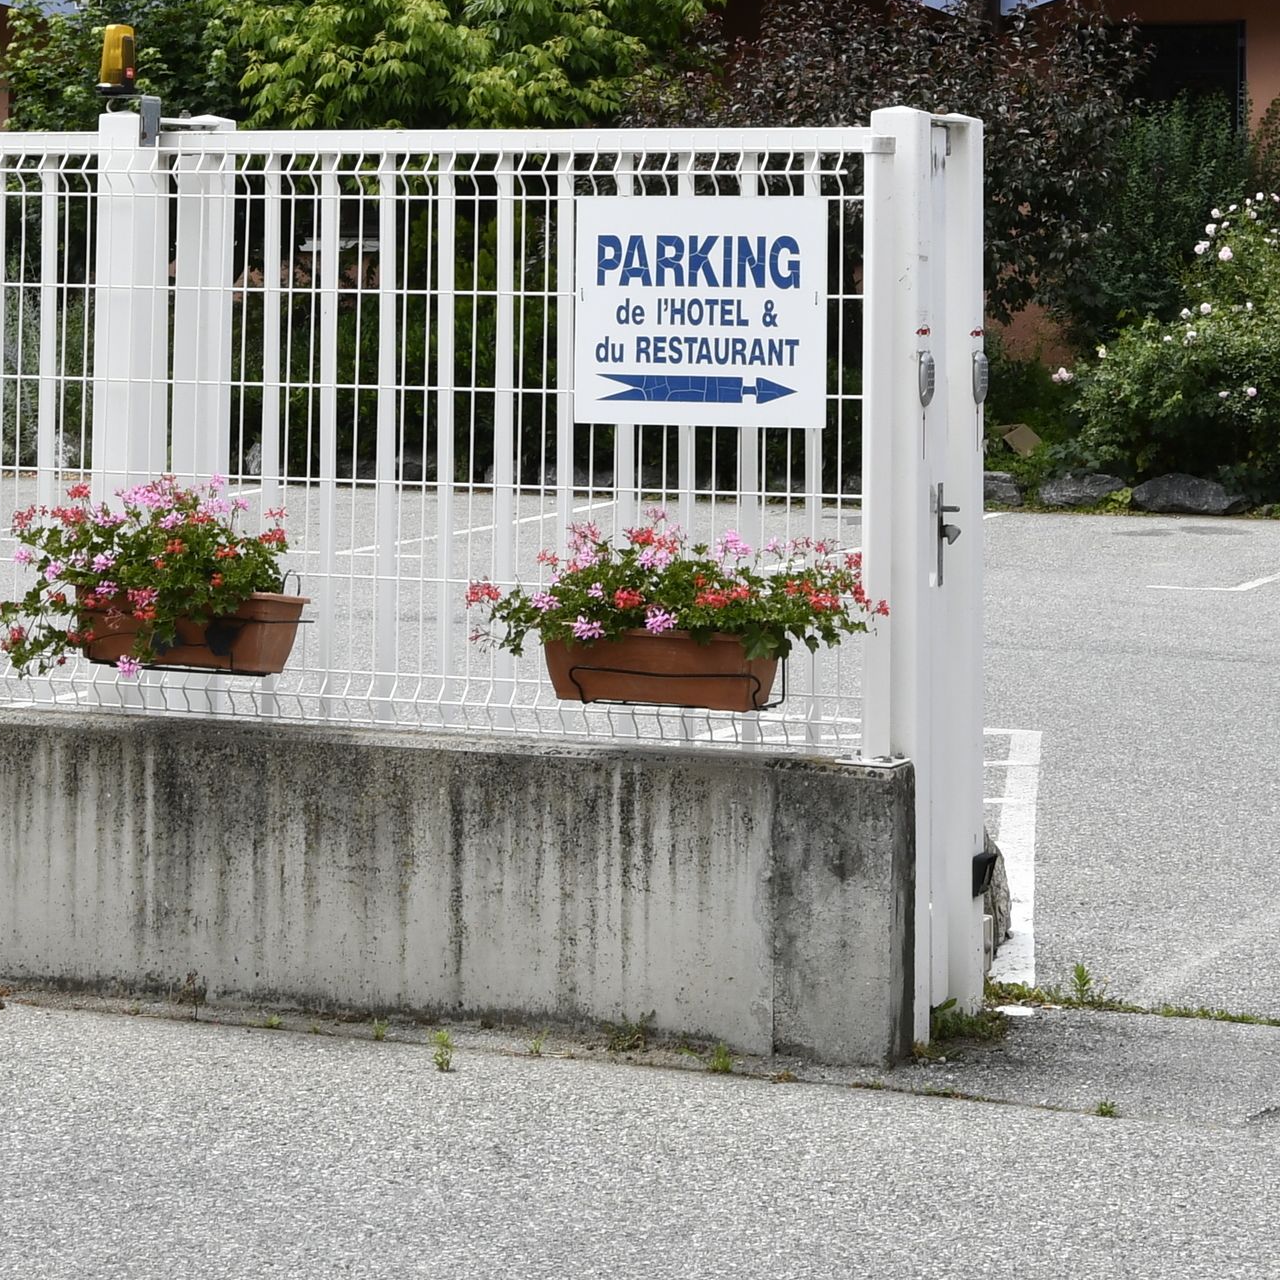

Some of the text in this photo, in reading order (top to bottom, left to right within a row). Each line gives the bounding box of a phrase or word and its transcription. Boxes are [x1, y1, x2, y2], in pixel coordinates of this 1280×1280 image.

[596, 234, 801, 290] PARKING
[616, 297, 779, 328] de l'HOTEL &
[595, 335, 800, 367] du RESTAURANT
